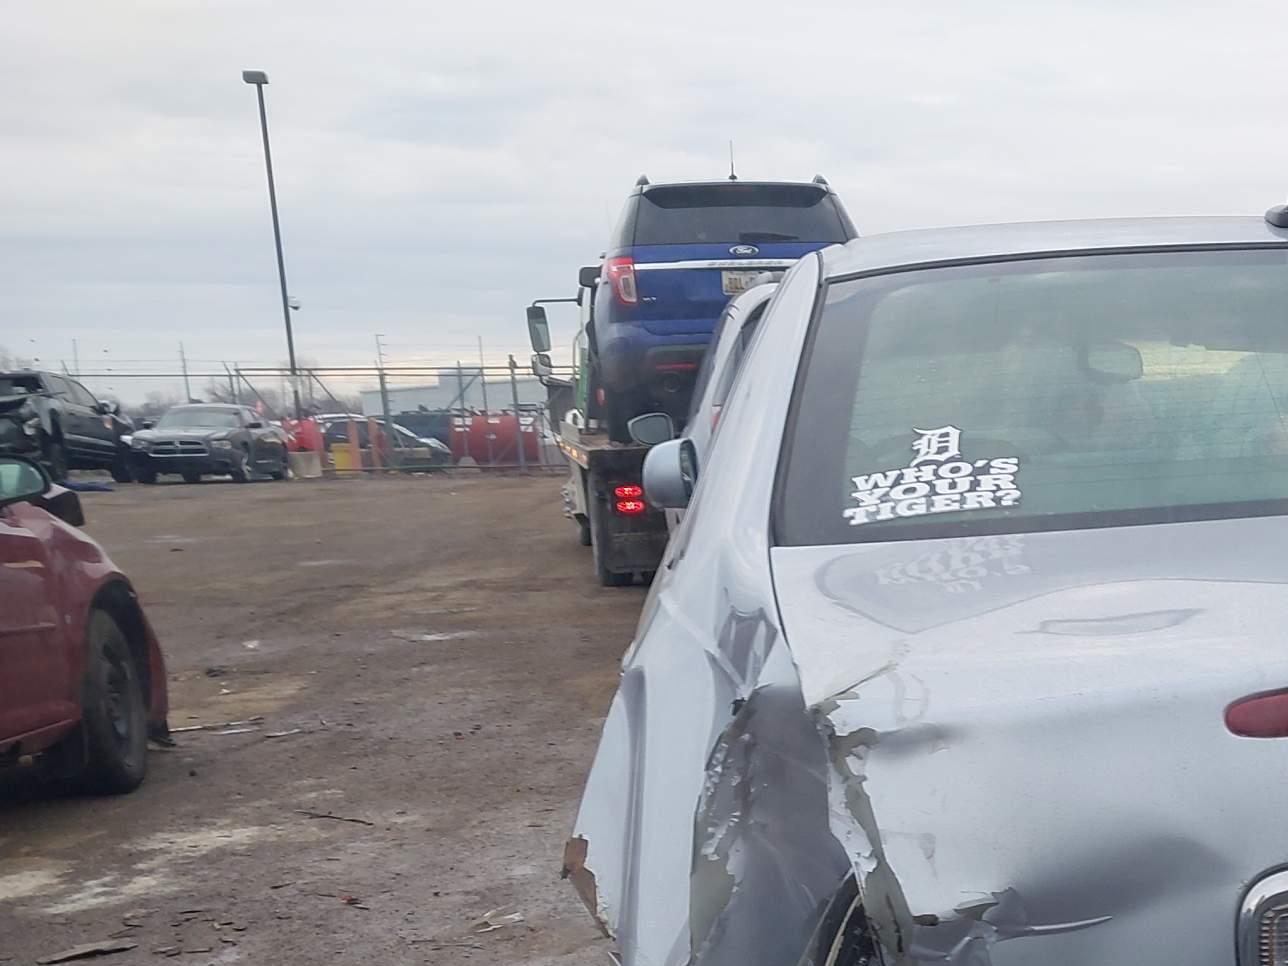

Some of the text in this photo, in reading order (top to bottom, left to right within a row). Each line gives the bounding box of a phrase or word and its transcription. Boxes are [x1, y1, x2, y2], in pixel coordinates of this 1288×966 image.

[909, 425, 962, 467] D
[851, 457, 1019, 491] WHO'S
[851, 473, 1017, 506] YOUR
[843, 489, 1022, 525] TIGER?
